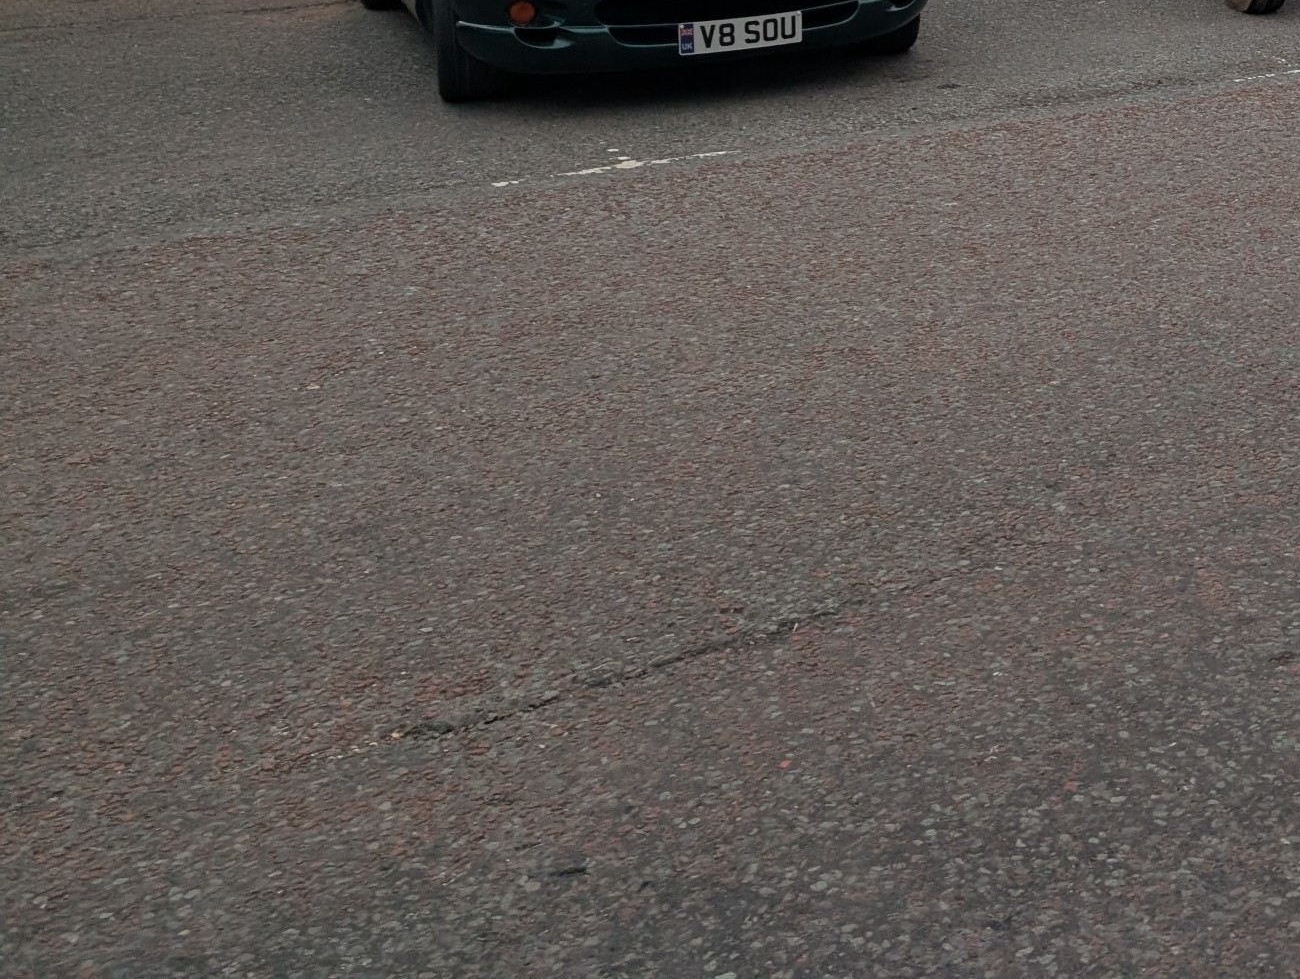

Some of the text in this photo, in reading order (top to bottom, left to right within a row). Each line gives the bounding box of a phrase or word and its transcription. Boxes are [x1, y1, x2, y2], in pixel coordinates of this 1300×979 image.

[699, 15, 797, 49] V8 SOU
[682, 42, 693, 50] UK
